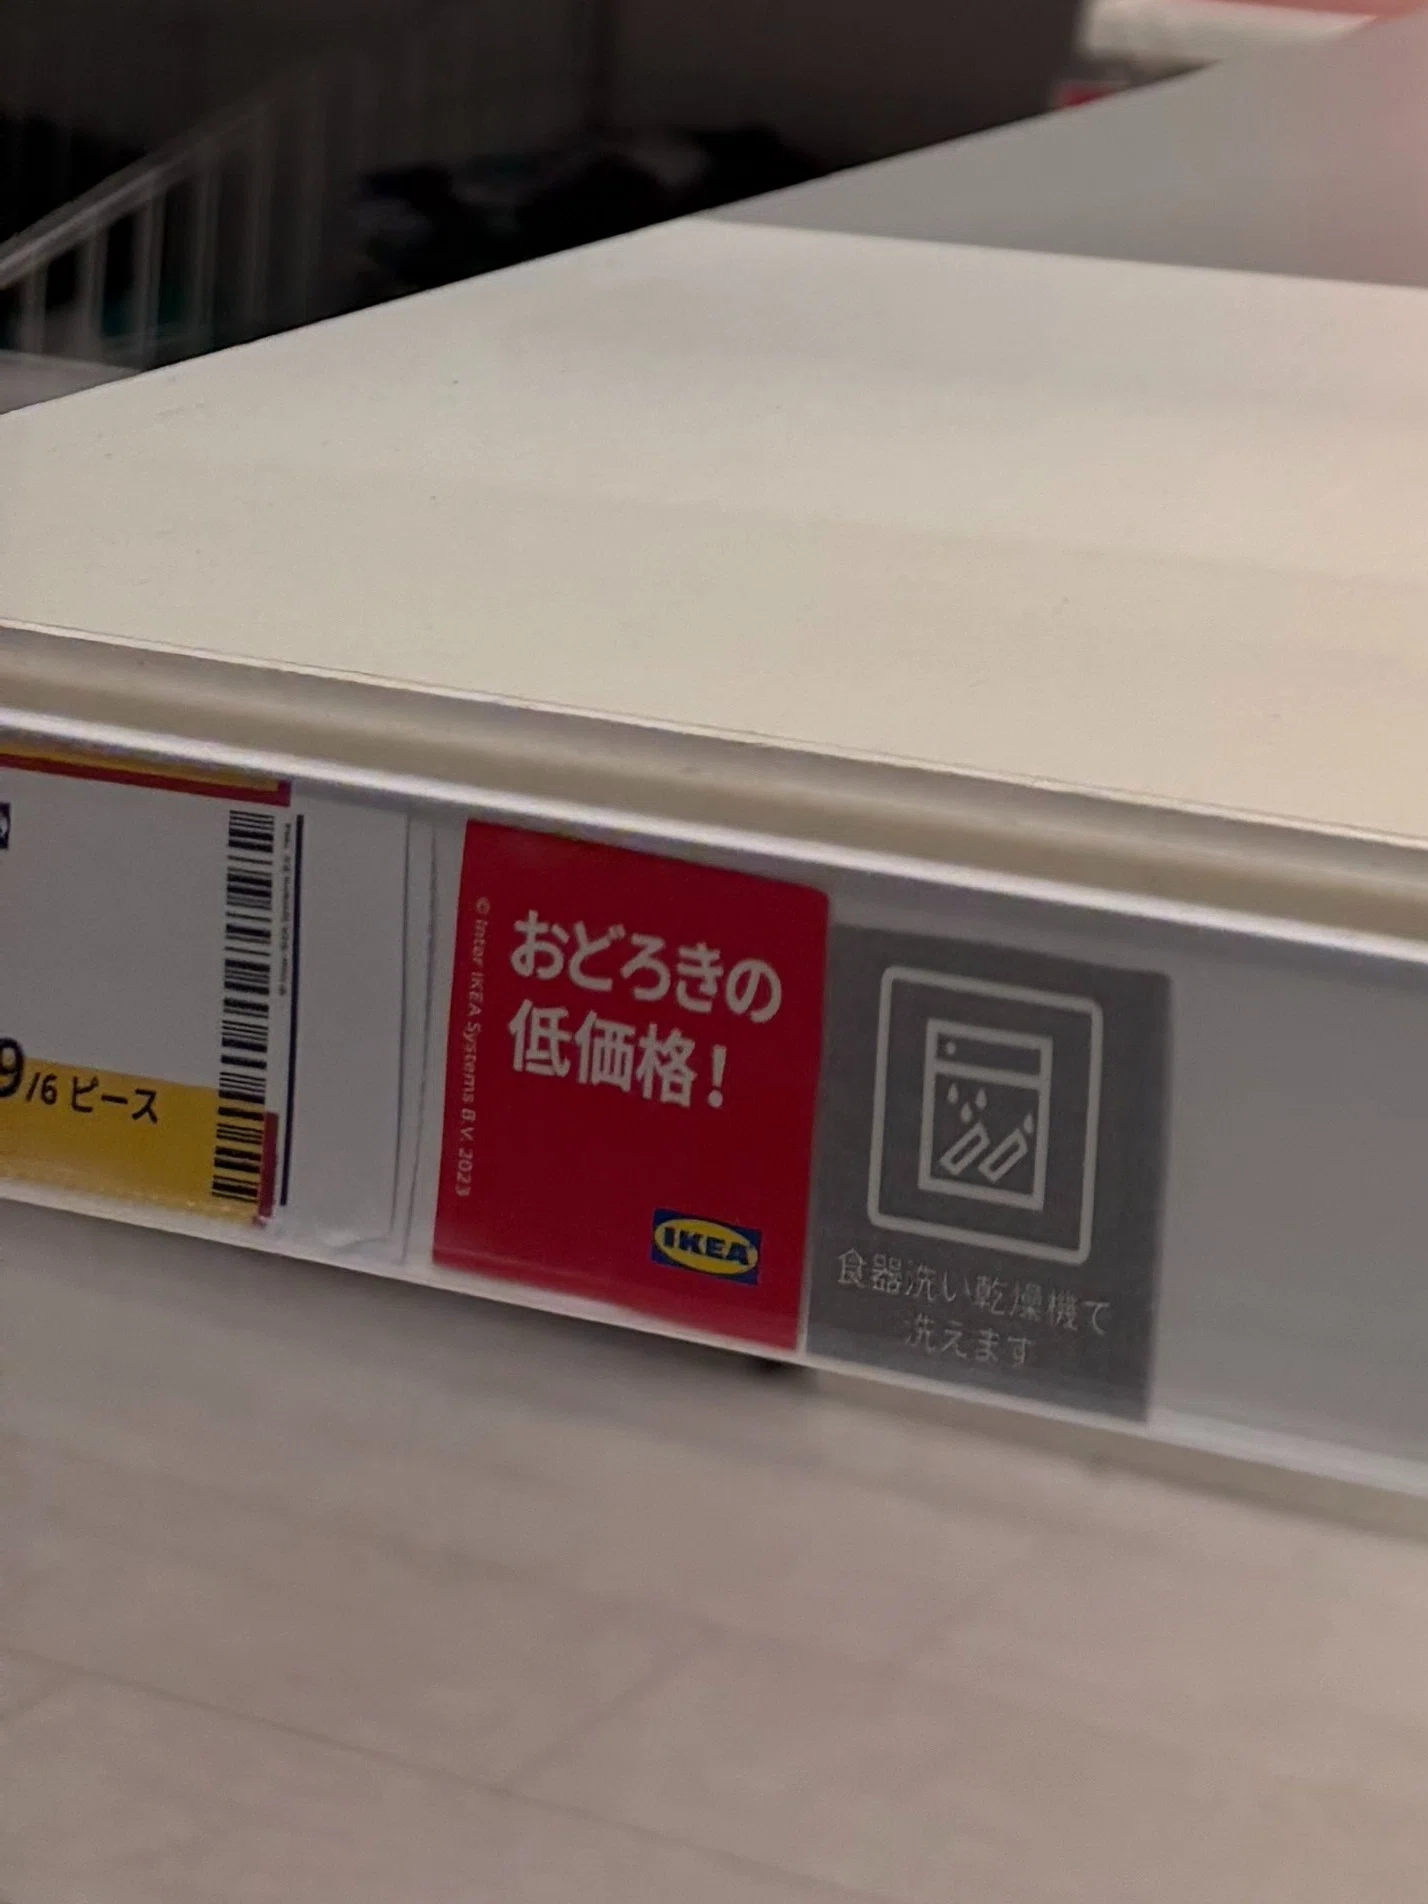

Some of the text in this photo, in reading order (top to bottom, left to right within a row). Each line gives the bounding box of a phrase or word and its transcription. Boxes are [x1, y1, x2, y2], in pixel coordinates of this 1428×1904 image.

[508, 909, 785, 1026] おどろきの
[467, 972, 486, 1017] IKEA
[664, 1226, 750, 1265] IKEA
[904, 1312, 1033, 1368] 洗えます
